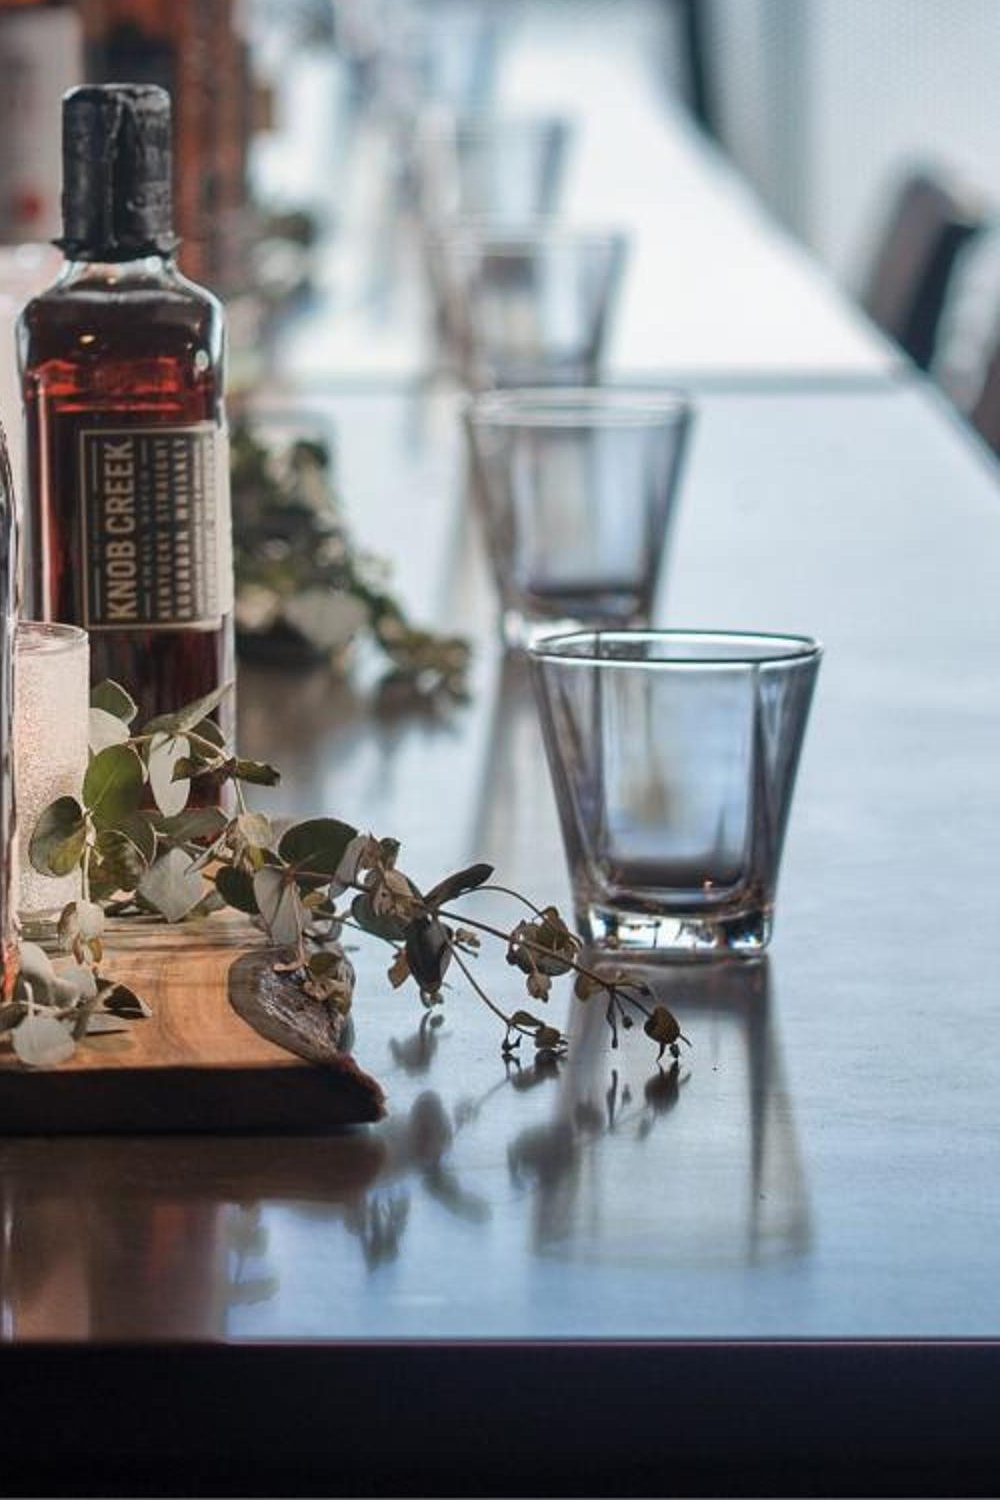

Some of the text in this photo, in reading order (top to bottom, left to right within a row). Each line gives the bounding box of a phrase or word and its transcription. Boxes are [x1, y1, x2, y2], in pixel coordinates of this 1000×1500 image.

[104, 441, 137, 619] KNOB CREEK
[155, 439, 172, 618] KENTUCKY STRAIGHT
[172, 438, 192, 618] BOURBON WHISKEY
